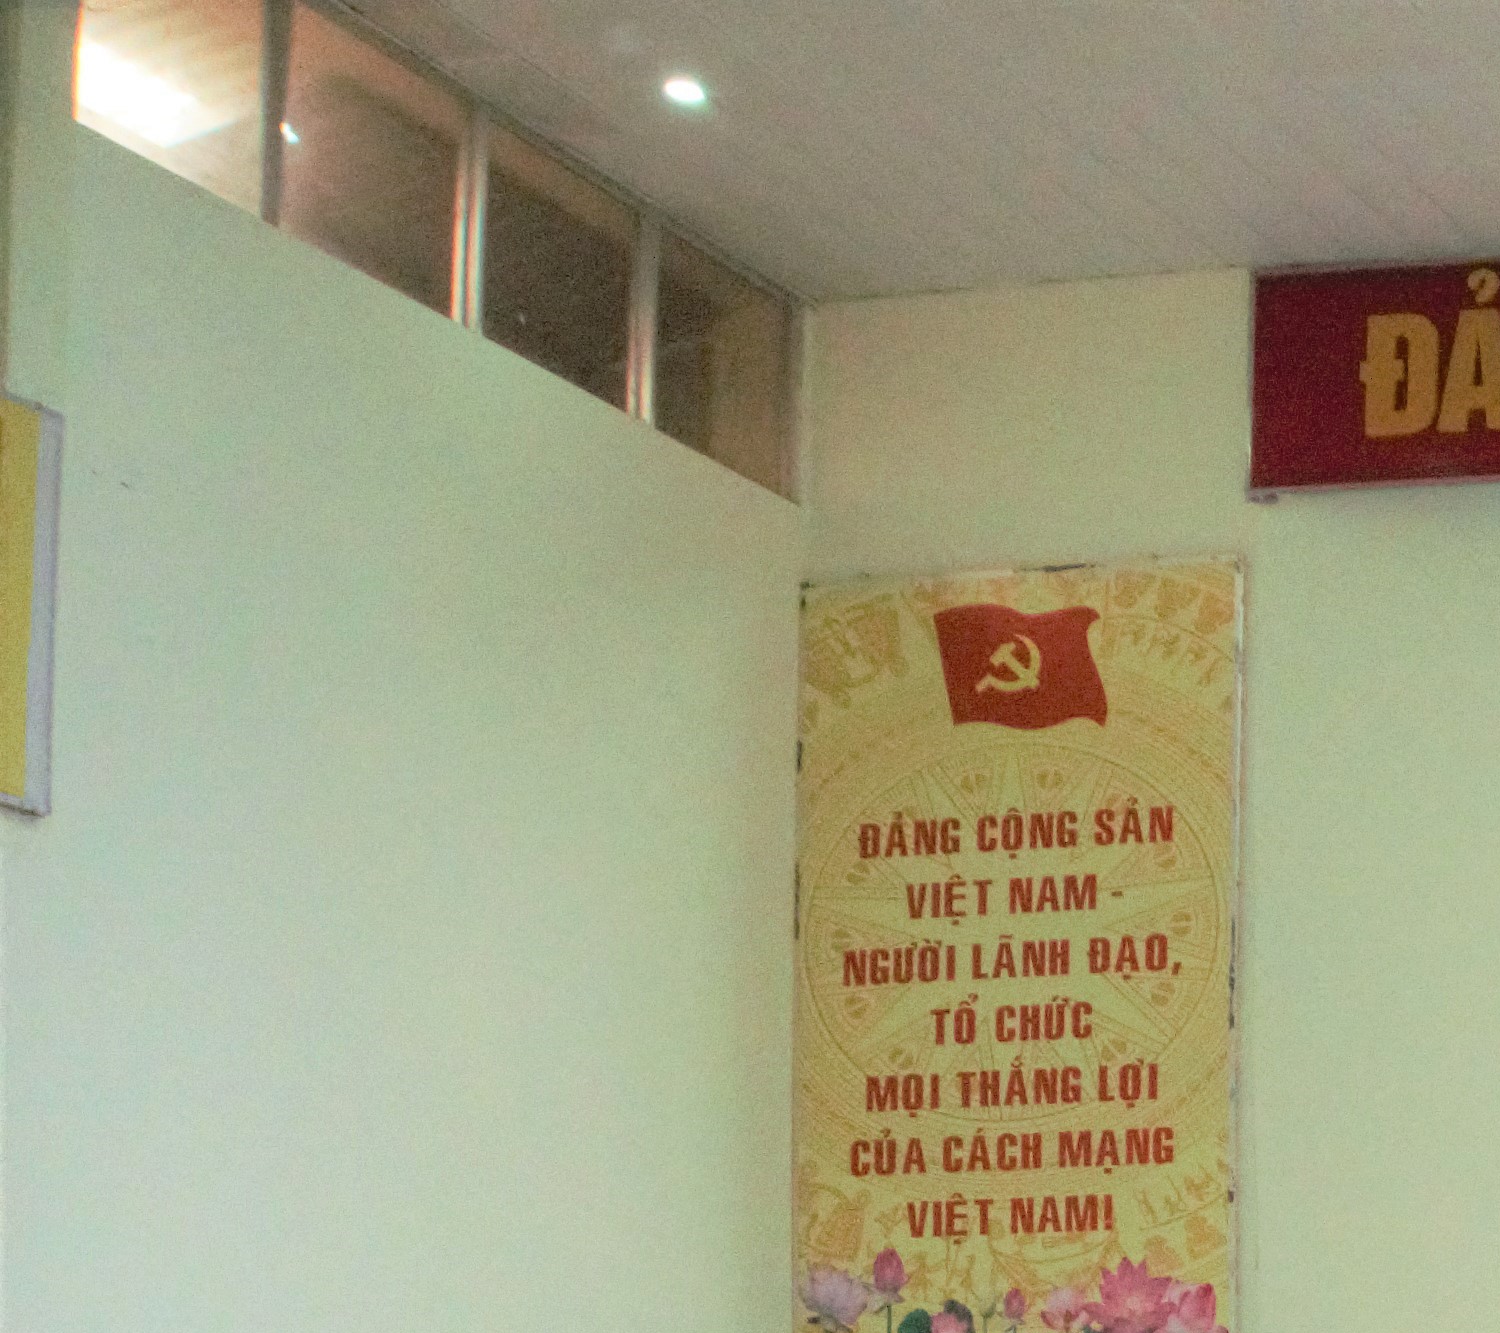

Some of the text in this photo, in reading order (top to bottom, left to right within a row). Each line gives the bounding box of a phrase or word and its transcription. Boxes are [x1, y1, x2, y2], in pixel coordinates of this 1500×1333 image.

[858, 799, 1173, 859] ĐẢNG CỘNG SẢN
[906, 875, 992, 925] VIỆT
[1010, 874, 1097, 913] NAM
[844, 934, 1181, 986] NGƯỜI LÃNH ĐẠO,
[931, 995, 1092, 1045] TỔ CHỨC
[866, 1055, 1158, 1117] MỌI THẮNG LỢI
[851, 1127, 1173, 1177] CỦA CÁCH MẠNG
[907, 1193, 1113, 1244] VIỆT NAM!
